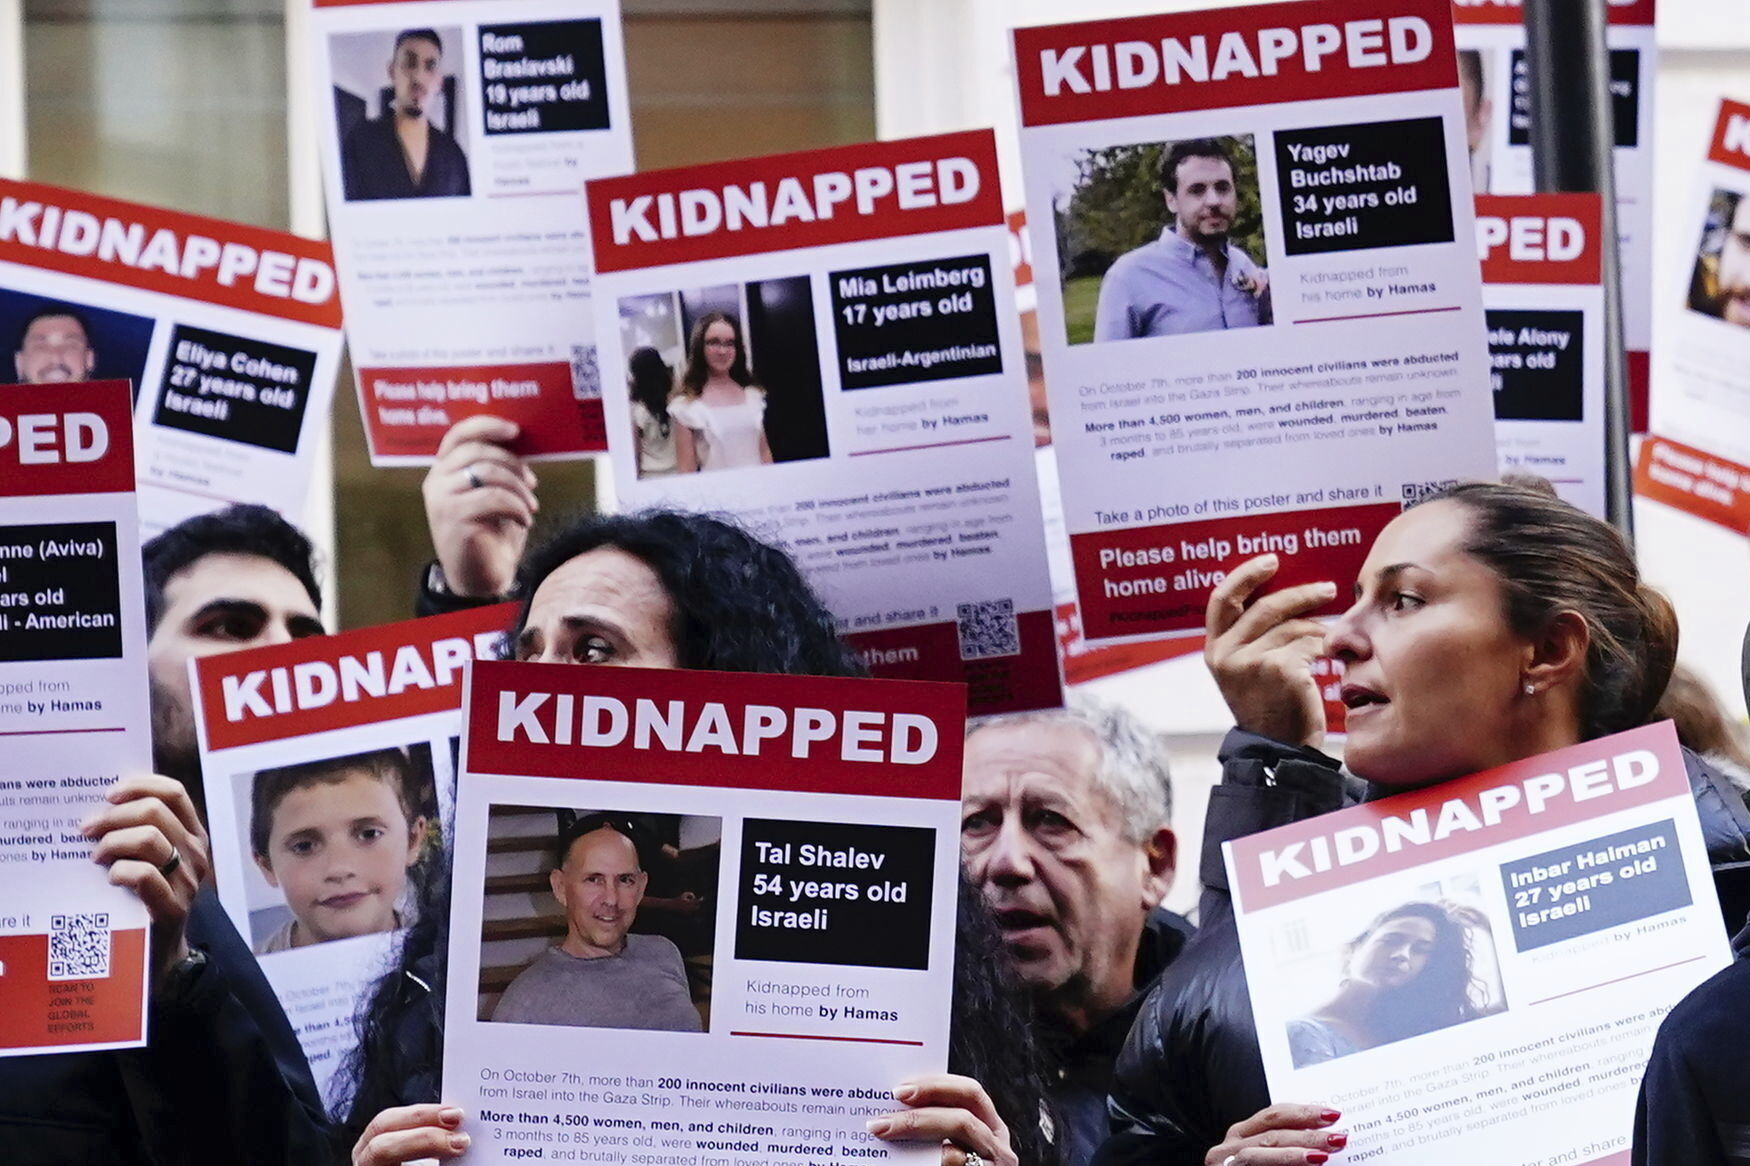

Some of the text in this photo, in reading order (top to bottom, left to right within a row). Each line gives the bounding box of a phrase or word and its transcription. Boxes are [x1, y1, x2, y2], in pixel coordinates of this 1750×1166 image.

[1040, 16, 1432, 95] KIDNAPPED
[1286, 143, 1350, 164] Yagev
[1290, 161, 1402, 188] Buchshtab
[610, 157, 979, 244] KIDNAPPED
[1293, 185, 1417, 215] 34 years old
[1295, 215, 1358, 239] Israeli
[0, 197, 335, 304] KIDNAPPED
[838, 266, 985, 298] Mia Leimberg
[1366, 281, 1436, 300] by Hamas
[842, 291, 973, 326] 17 years old
[846, 343, 997, 373] Israeli-Argentinian
[39, 538, 104, 562] (Aviva)
[34, 588, 65, 606] old
[24, 611, 115, 630] American
[27, 700, 102, 714] by Hamas
[497, 691, 937, 764] KIDNAPPED
[1259, 750, 1659, 886] KIDNAPPED
[754, 841, 885, 870] Tal Shalev
[1510, 835, 1666, 888] Inbar Haiman
[752, 873, 907, 903] 54 years old
[1514, 855, 1657, 908] 27 years old
[750, 904, 828, 930] Israeli
[1518, 894, 1591, 928] Israeli
[746, 978, 869, 999] Kidnapped from
[745, 1001, 898, 1022] his home by Hamas
